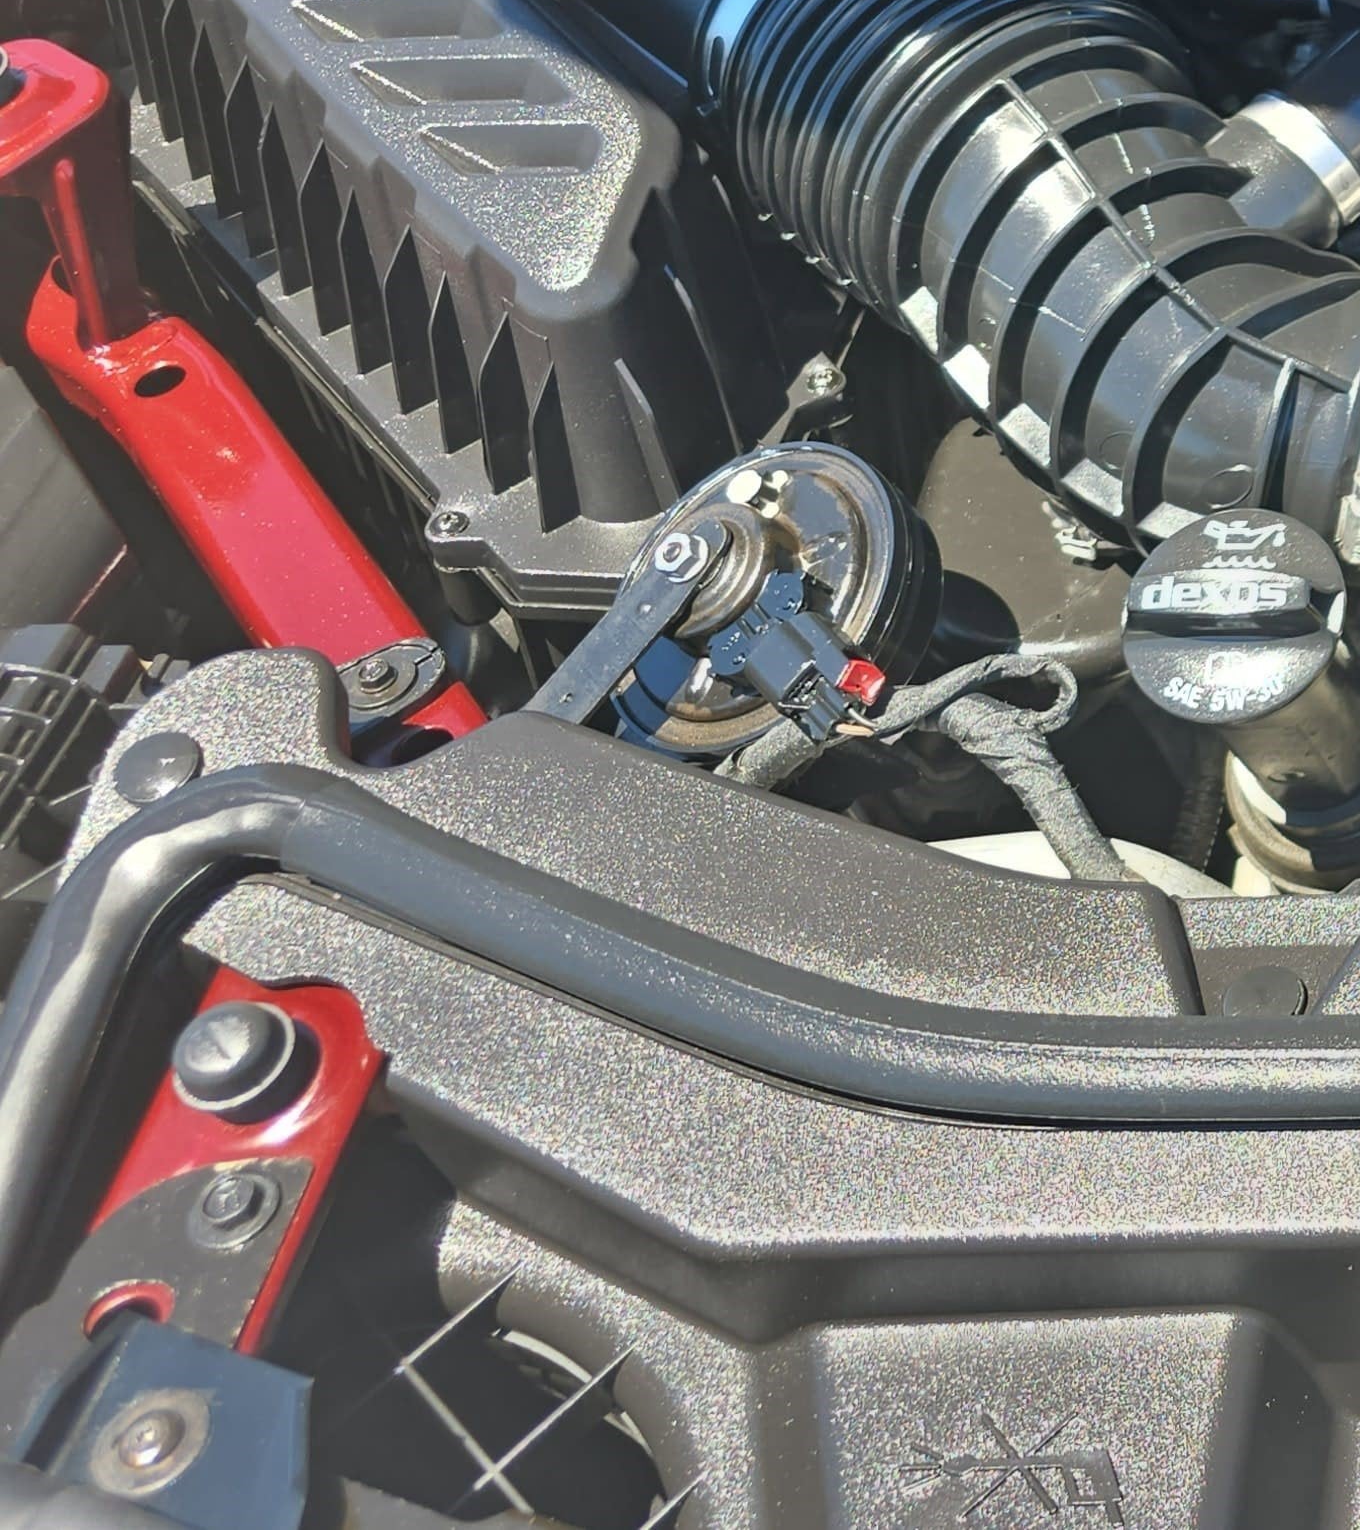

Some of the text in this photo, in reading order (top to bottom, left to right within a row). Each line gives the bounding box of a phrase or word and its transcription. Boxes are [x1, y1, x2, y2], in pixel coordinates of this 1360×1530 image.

[1140, 575, 1290, 609] dexos
[1163, 671, 1285, 711] SAE 5W-30
